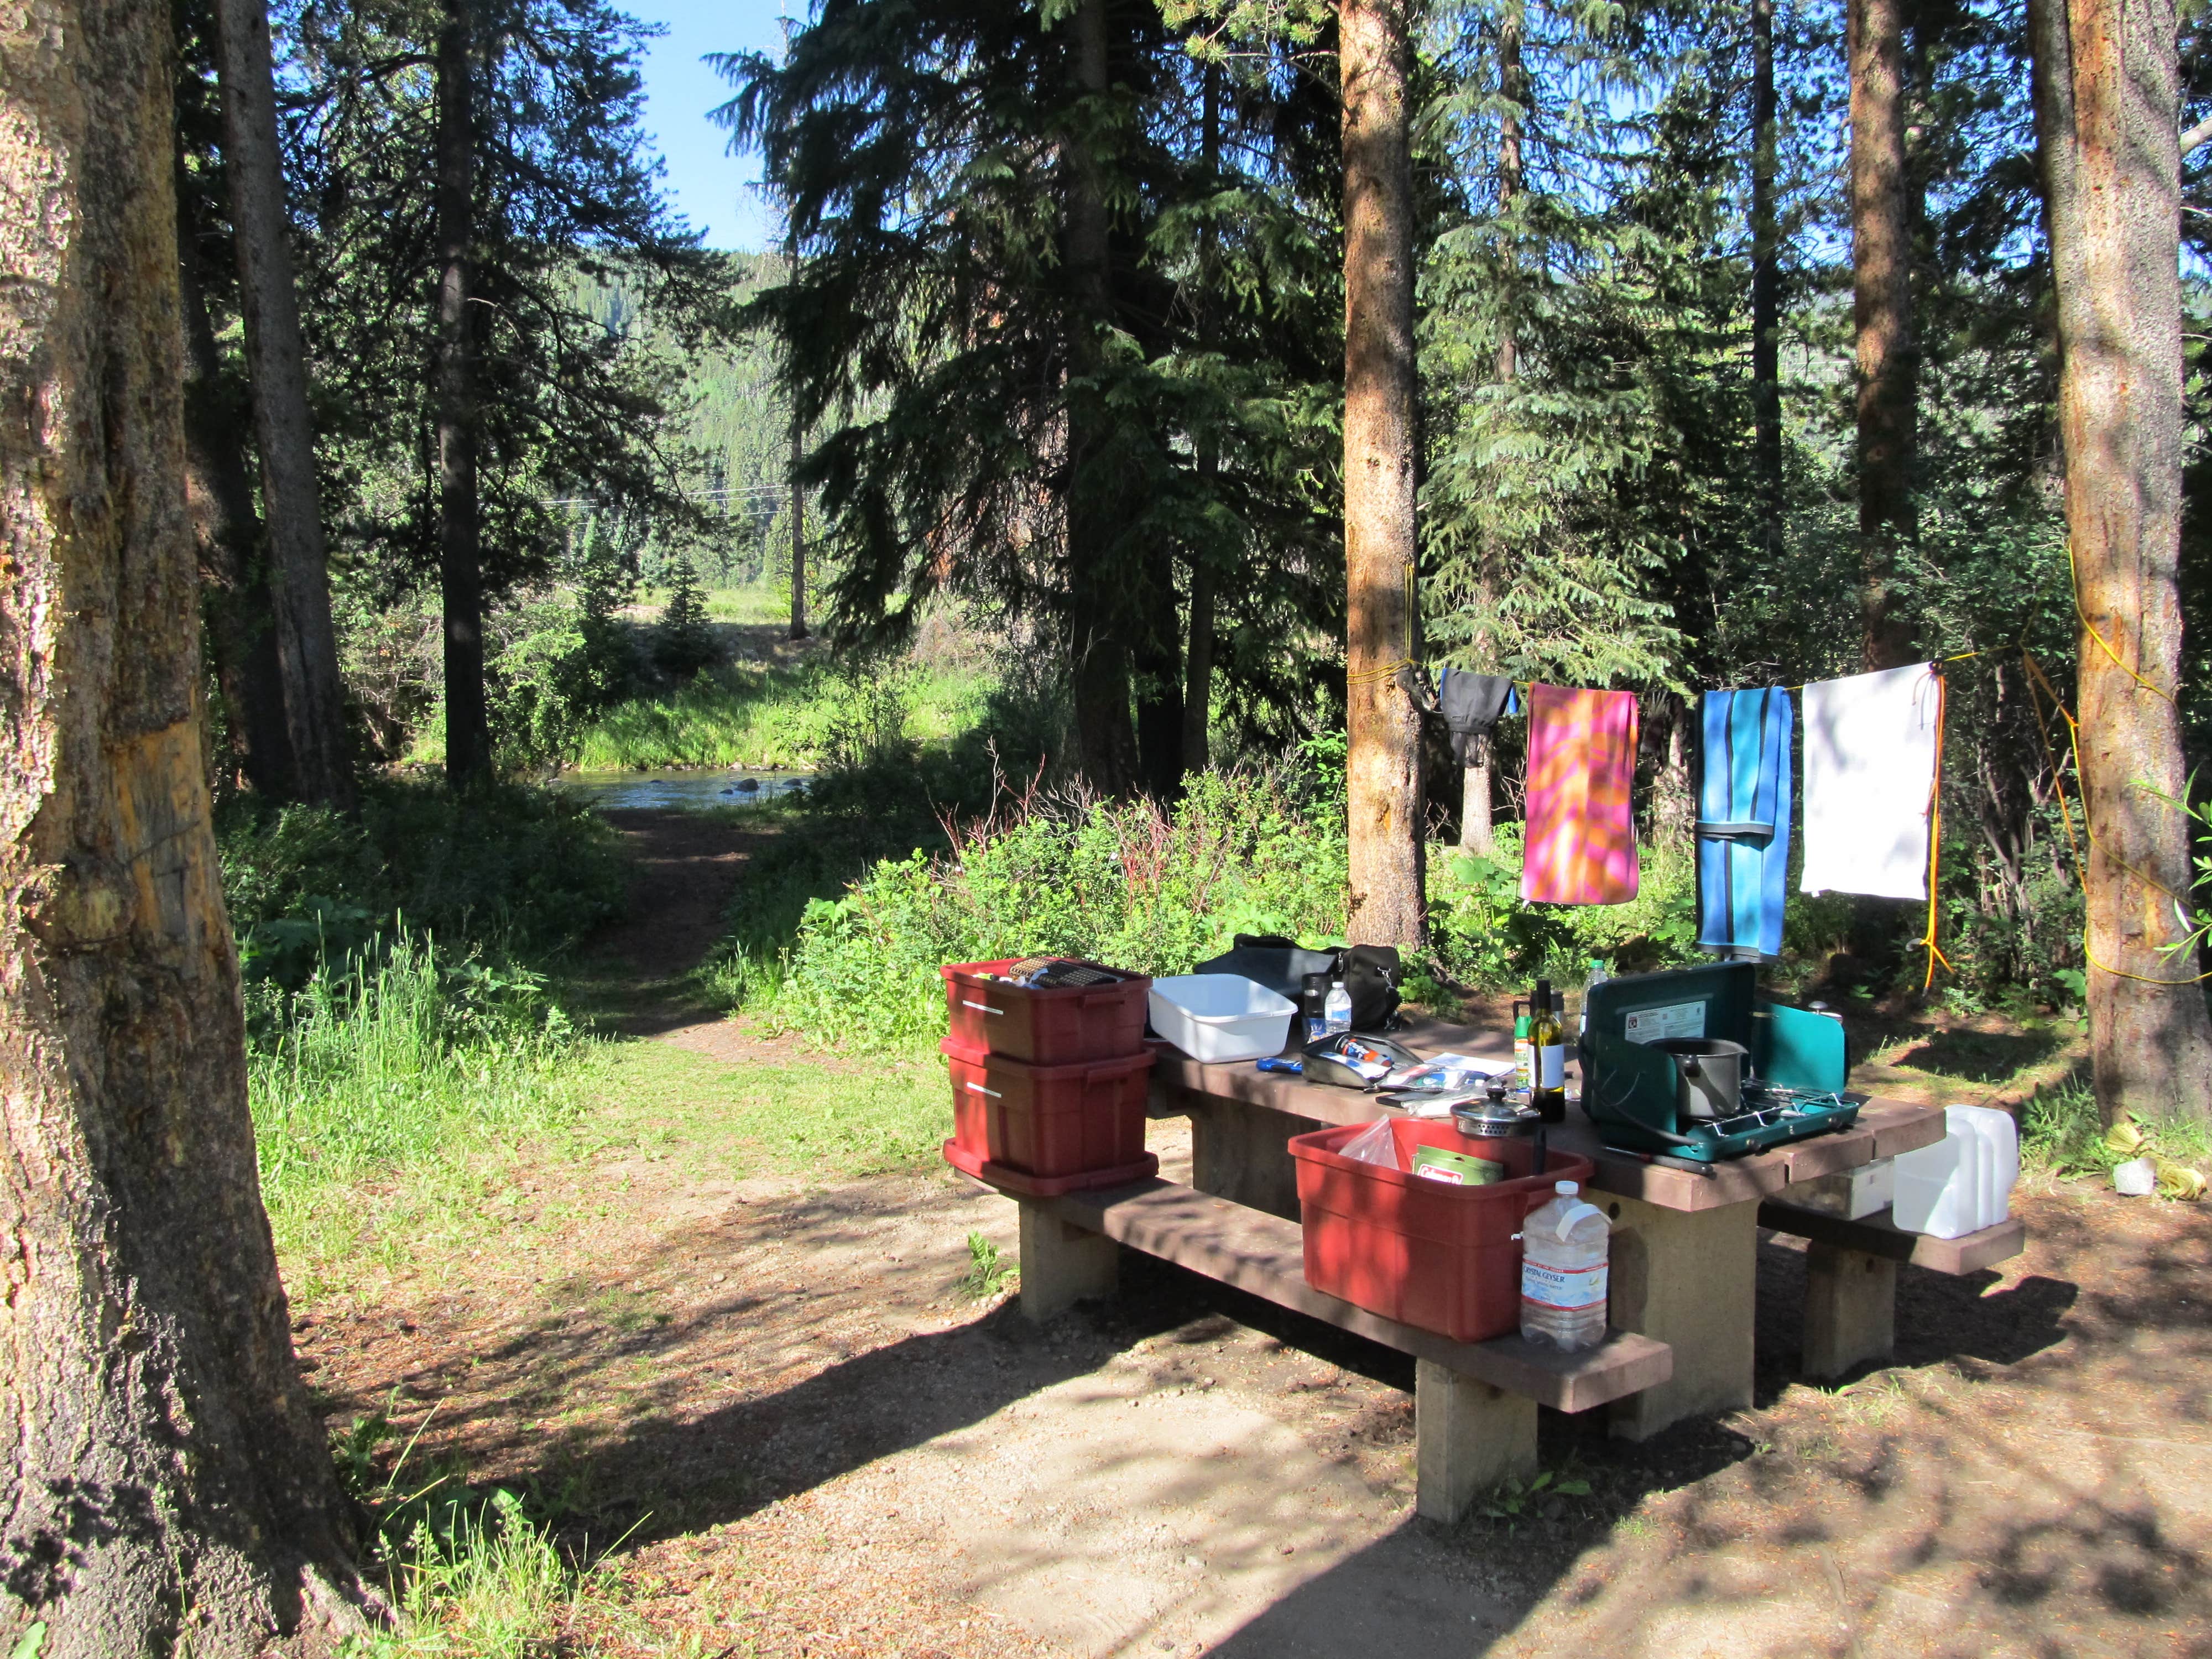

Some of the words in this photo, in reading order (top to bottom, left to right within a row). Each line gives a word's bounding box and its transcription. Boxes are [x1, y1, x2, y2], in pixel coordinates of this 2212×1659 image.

[1348, 1042, 1370, 1055] edge
[1421, 1167, 1452, 1183] Coleman
[1524, 1265, 1542, 1277] CRYSTAL
[1542, 1272, 1565, 1282] GEYSER
